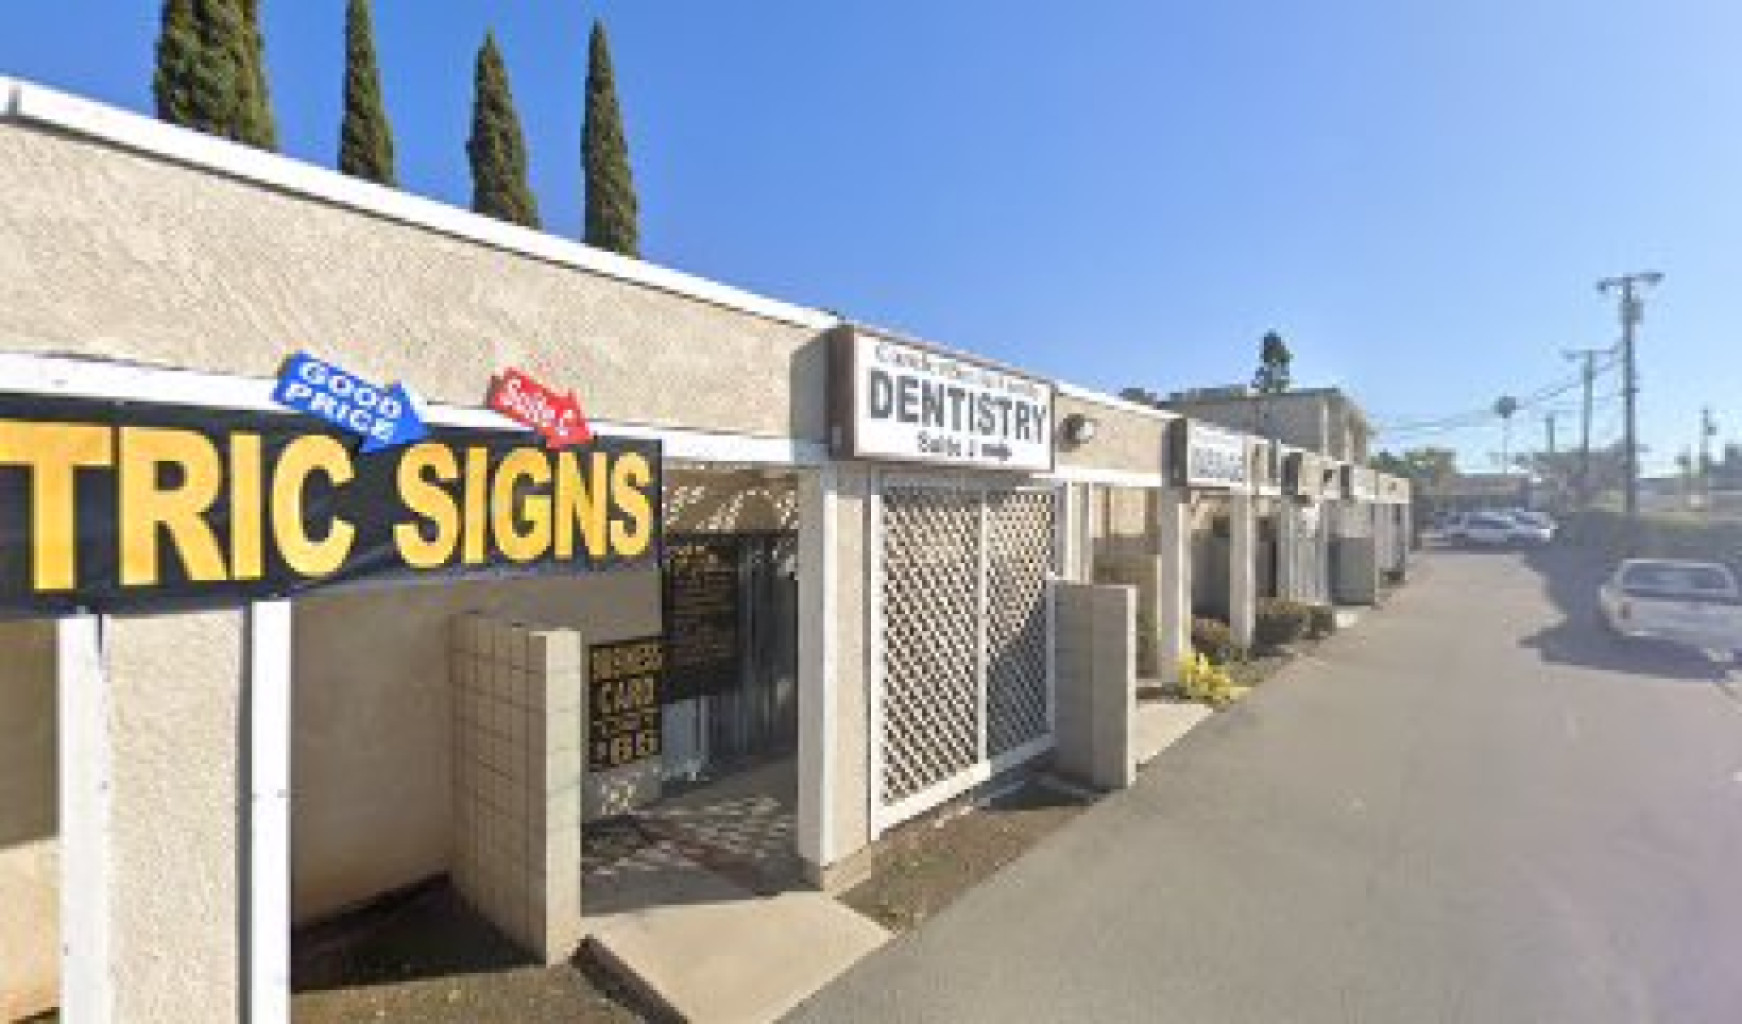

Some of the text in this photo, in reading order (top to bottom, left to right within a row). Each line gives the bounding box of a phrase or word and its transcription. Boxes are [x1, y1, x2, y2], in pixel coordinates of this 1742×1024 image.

[285, 383, 394, 441] PRICE
[299, 361, 402, 419] GOOD
[868, 369, 1047, 444] DENTISTRY
[0, 421, 653, 591] TRIC SIGNS
